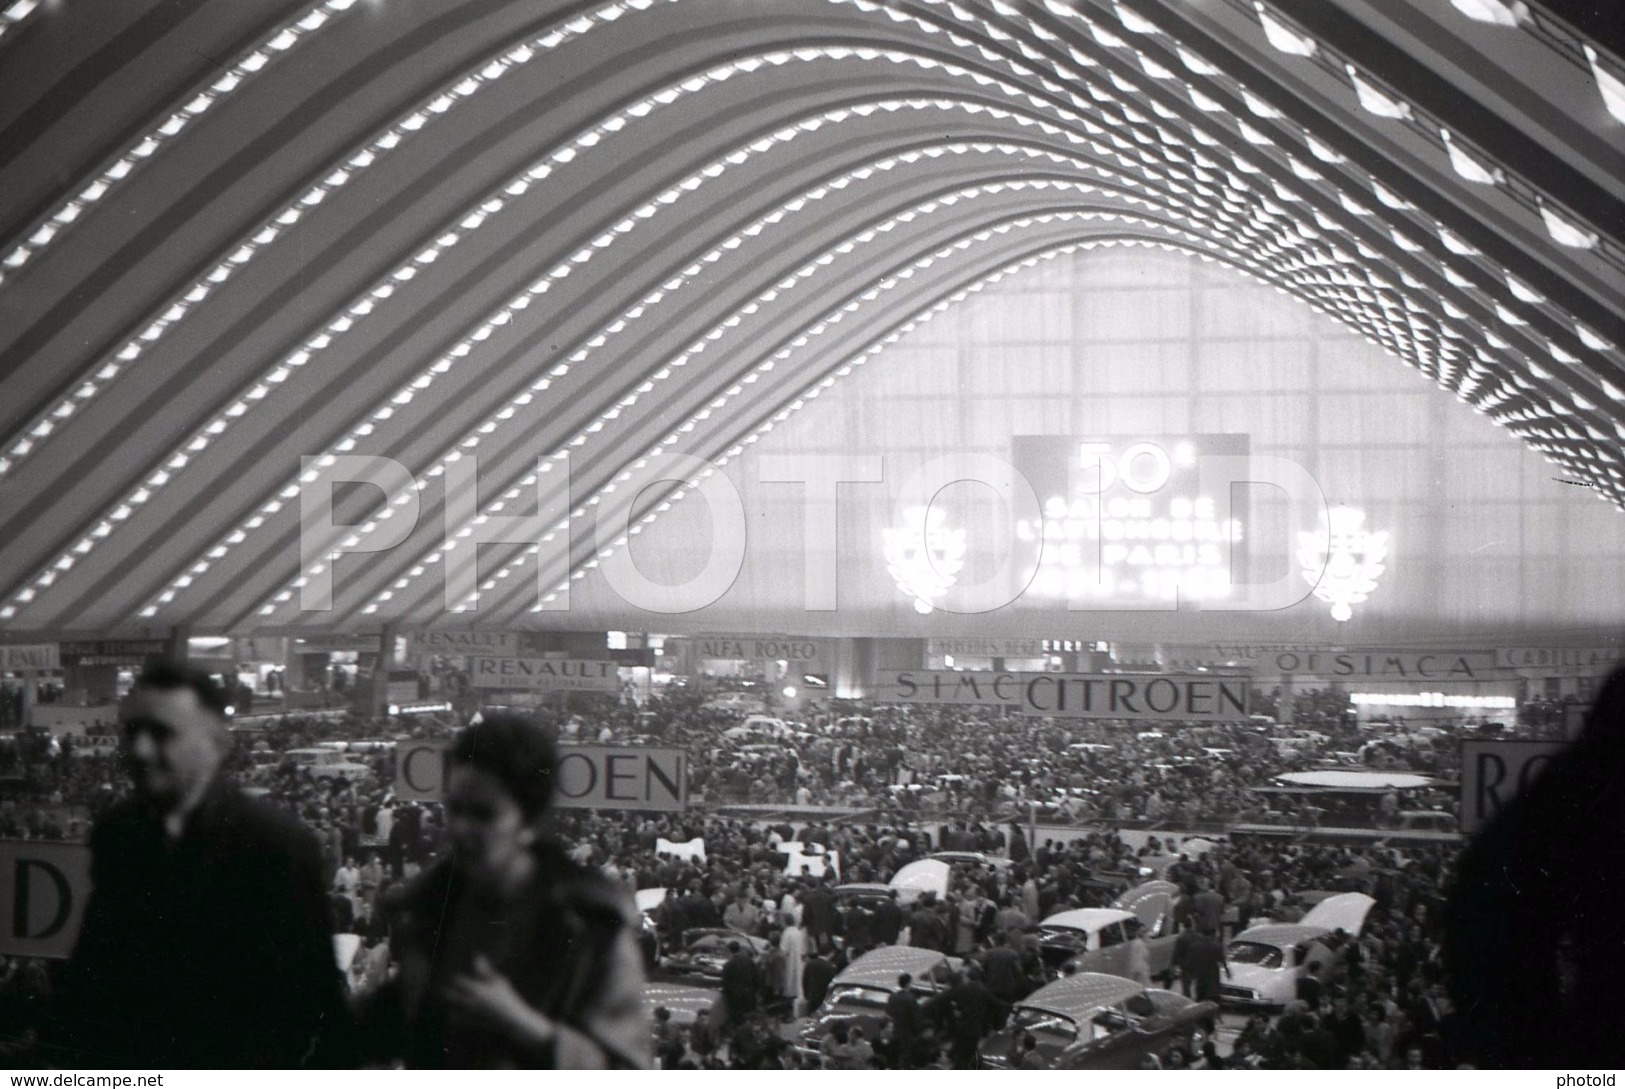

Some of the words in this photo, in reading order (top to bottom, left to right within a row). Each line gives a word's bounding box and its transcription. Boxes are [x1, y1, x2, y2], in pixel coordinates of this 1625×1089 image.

[1044, 495, 1152, 519] SALON
[1169, 495, 1216, 519] DE
[1102, 543, 1223, 565] PARIS
[413, 632, 508, 646] RENAULT
[700, 641, 744, 658] ALFA
[754, 642, 817, 660] ROMEO
[480, 659, 612, 679] RENAULT
[1333, 654, 1475, 678] SIMCA
[895, 673, 1015, 700] SIMC
[1027, 676, 1246, 715] CITROEN
[403, 747, 682, 803] COEN
